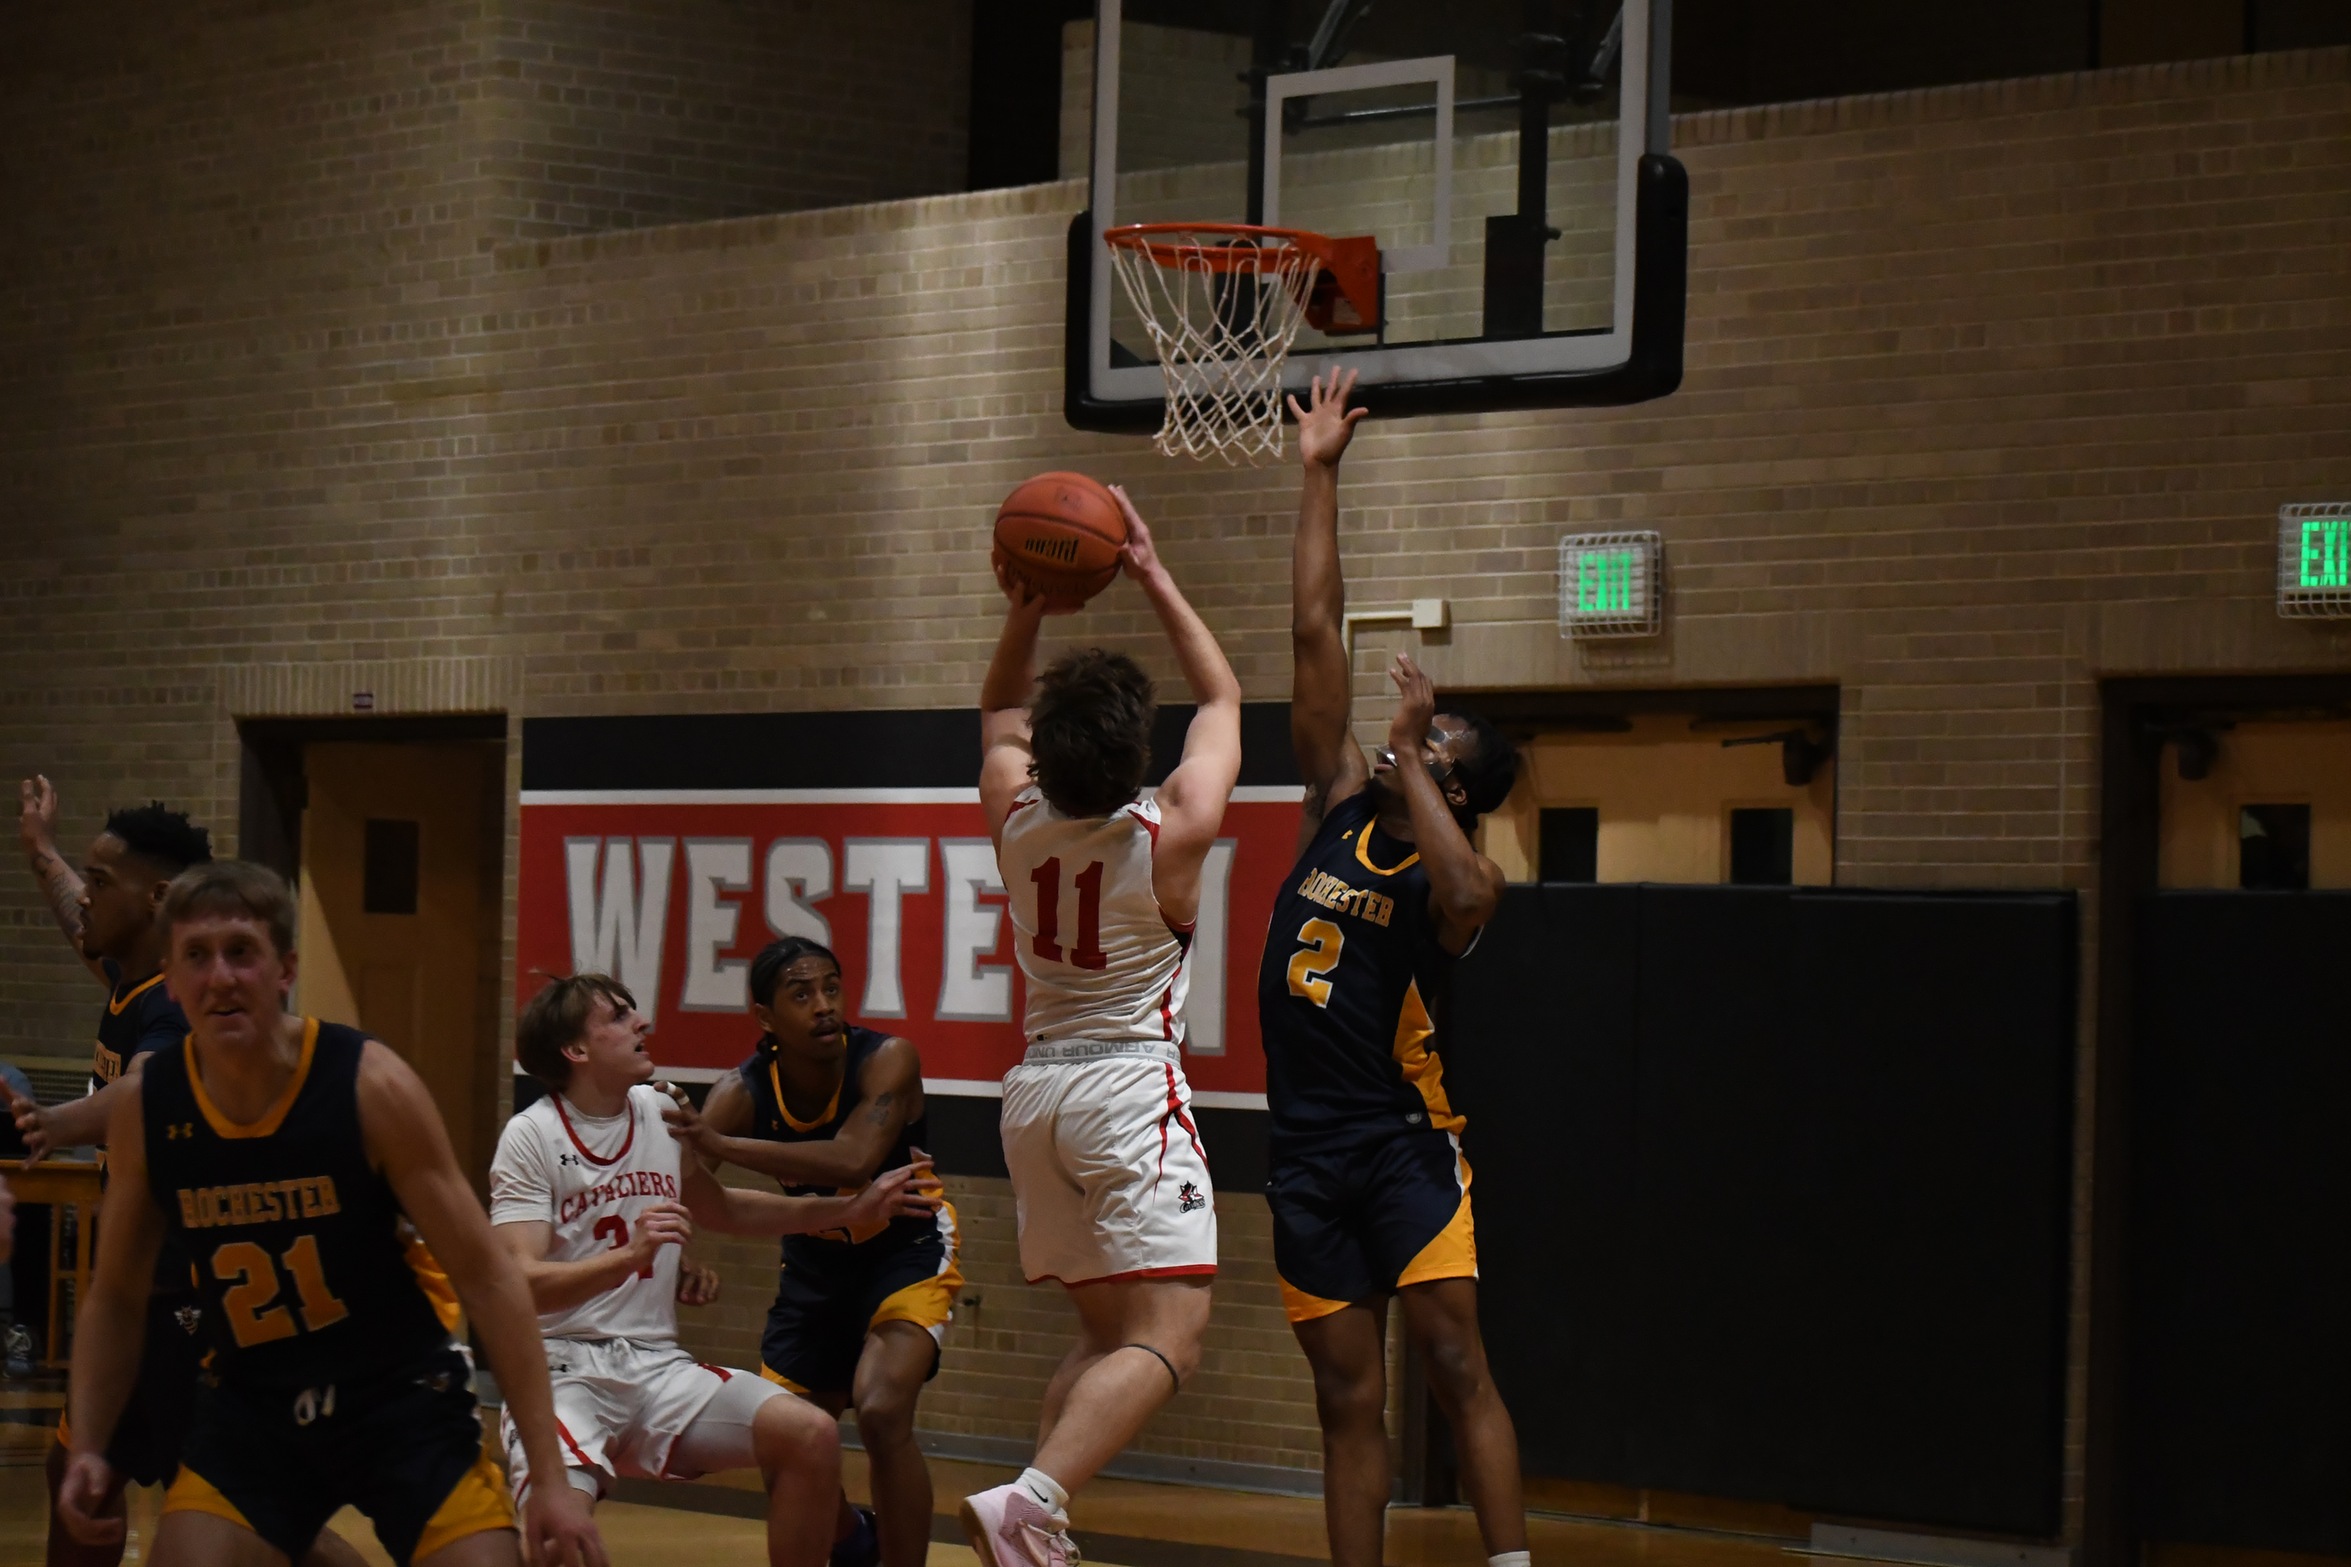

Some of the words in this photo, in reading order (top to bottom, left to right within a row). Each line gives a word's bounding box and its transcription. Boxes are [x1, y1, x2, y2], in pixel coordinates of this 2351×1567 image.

[1578, 552, 1632, 611] EXIT
[563, 835, 1239, 1057] WESTE
[1030, 856, 1107, 970] 11
[1286, 916, 1346, 1010] 2
[176, 1175, 342, 1230] ROCHESTER
[210, 1234, 350, 1349] 21
